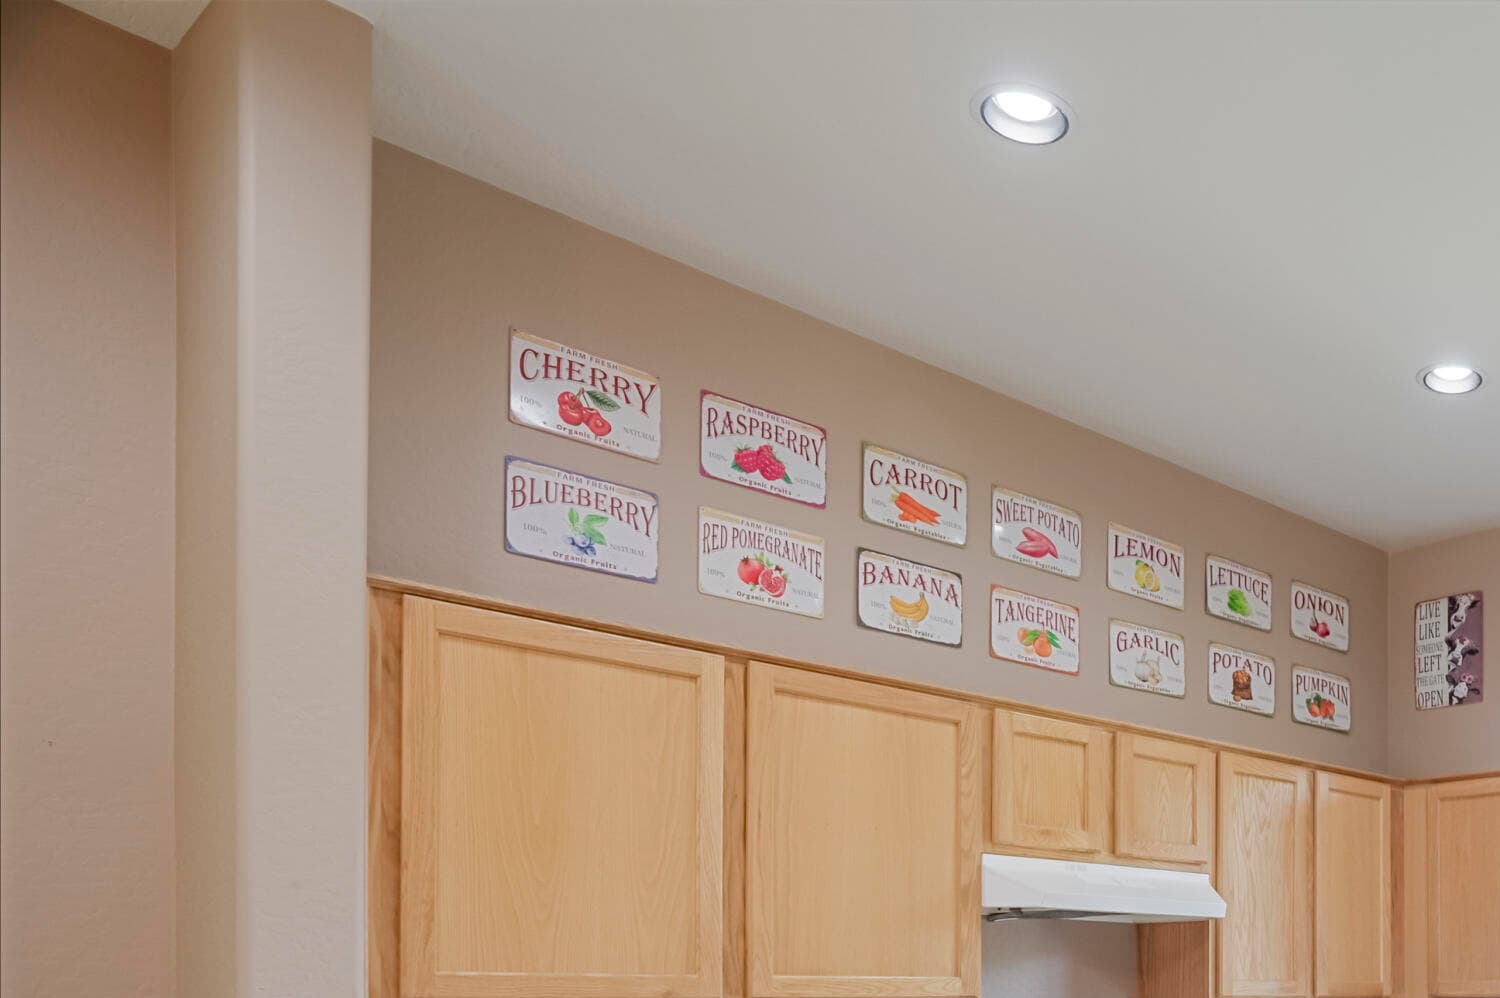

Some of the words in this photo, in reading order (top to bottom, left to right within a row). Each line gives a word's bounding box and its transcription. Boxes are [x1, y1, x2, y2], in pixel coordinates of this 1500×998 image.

[560, 345, 587, 360] FARM
[589, 355, 619, 371] FRESH
[519, 347, 657, 416] CHERRY
[741, 405, 765, 418] FARM
[556, 423, 592, 440] Organic
[594, 434, 621, 448] Fruits
[706, 407, 825, 468] RASPBERRY
[557, 472, 583, 484] FARM
[586, 480, 616, 493] FRESH
[738, 475, 768, 489] Organic
[869, 458, 963, 512] CARROT
[511, 474, 657, 539] BLUEBERRY
[995, 497, 1035, 524] SWEET
[1037, 508, 1080, 550] POTATO
[740, 519, 762, 530] FARM
[552, 549, 588, 565] Organic
[590, 557, 618, 571] Fruits
[702, 521, 728, 555] RED
[731, 527, 823, 582] POMEGRANATE
[1113, 534, 1182, 579] LEMON
[736, 589, 765, 603] Organic
[862, 561, 960, 609] BANANA
[1209, 564, 1269, 606] LETTUCE
[994, 598, 1077, 643] TANGERINE
[1294, 590, 1346, 626] ONION
[1419, 601, 1441, 620] LIVE
[1419, 621, 1441, 641] LIKE
[1116, 630, 1181, 667] GARLIC
[1418, 654, 1442, 674] LEFT
[1212, 651, 1273, 687] POTATO
[1295, 674, 1349, 707] PUMPKIN
[1417, 690, 1444, 708] OPEN
